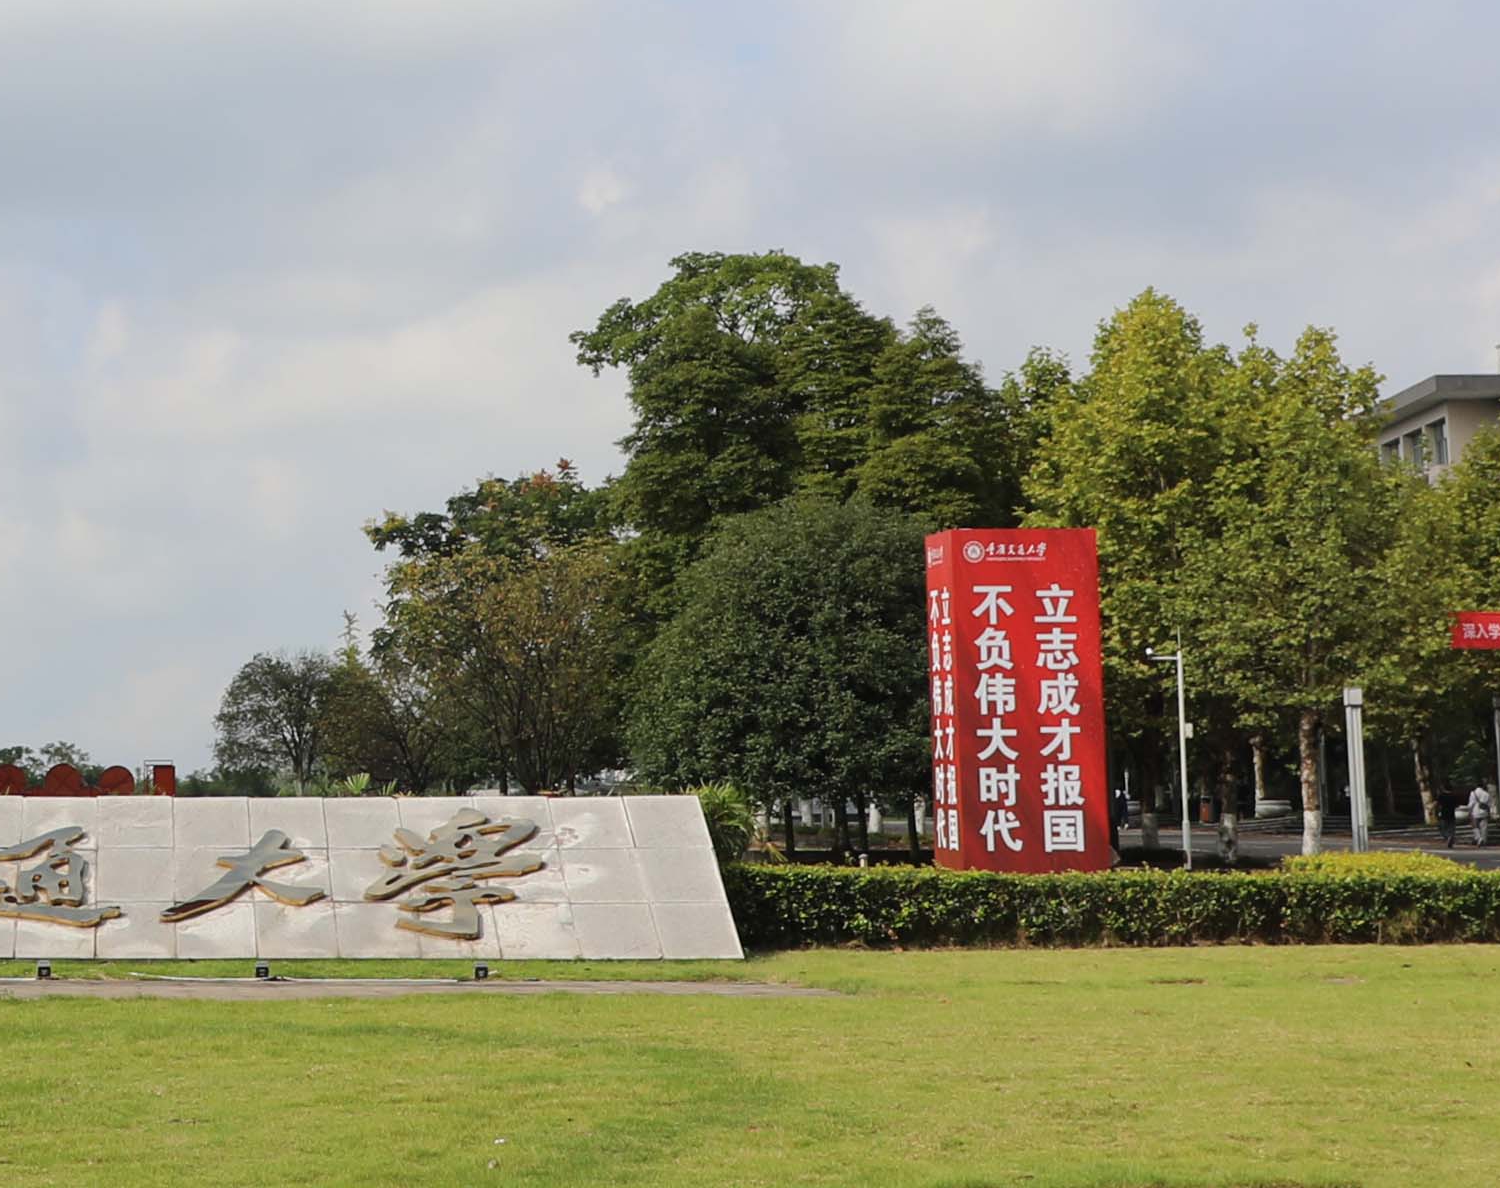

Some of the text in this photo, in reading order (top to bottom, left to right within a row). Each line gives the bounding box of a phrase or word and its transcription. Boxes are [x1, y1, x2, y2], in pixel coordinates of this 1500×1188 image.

[973, 584, 1024, 853] 不负伟大时代
[1033, 583, 1085, 853] 立志成才报国
